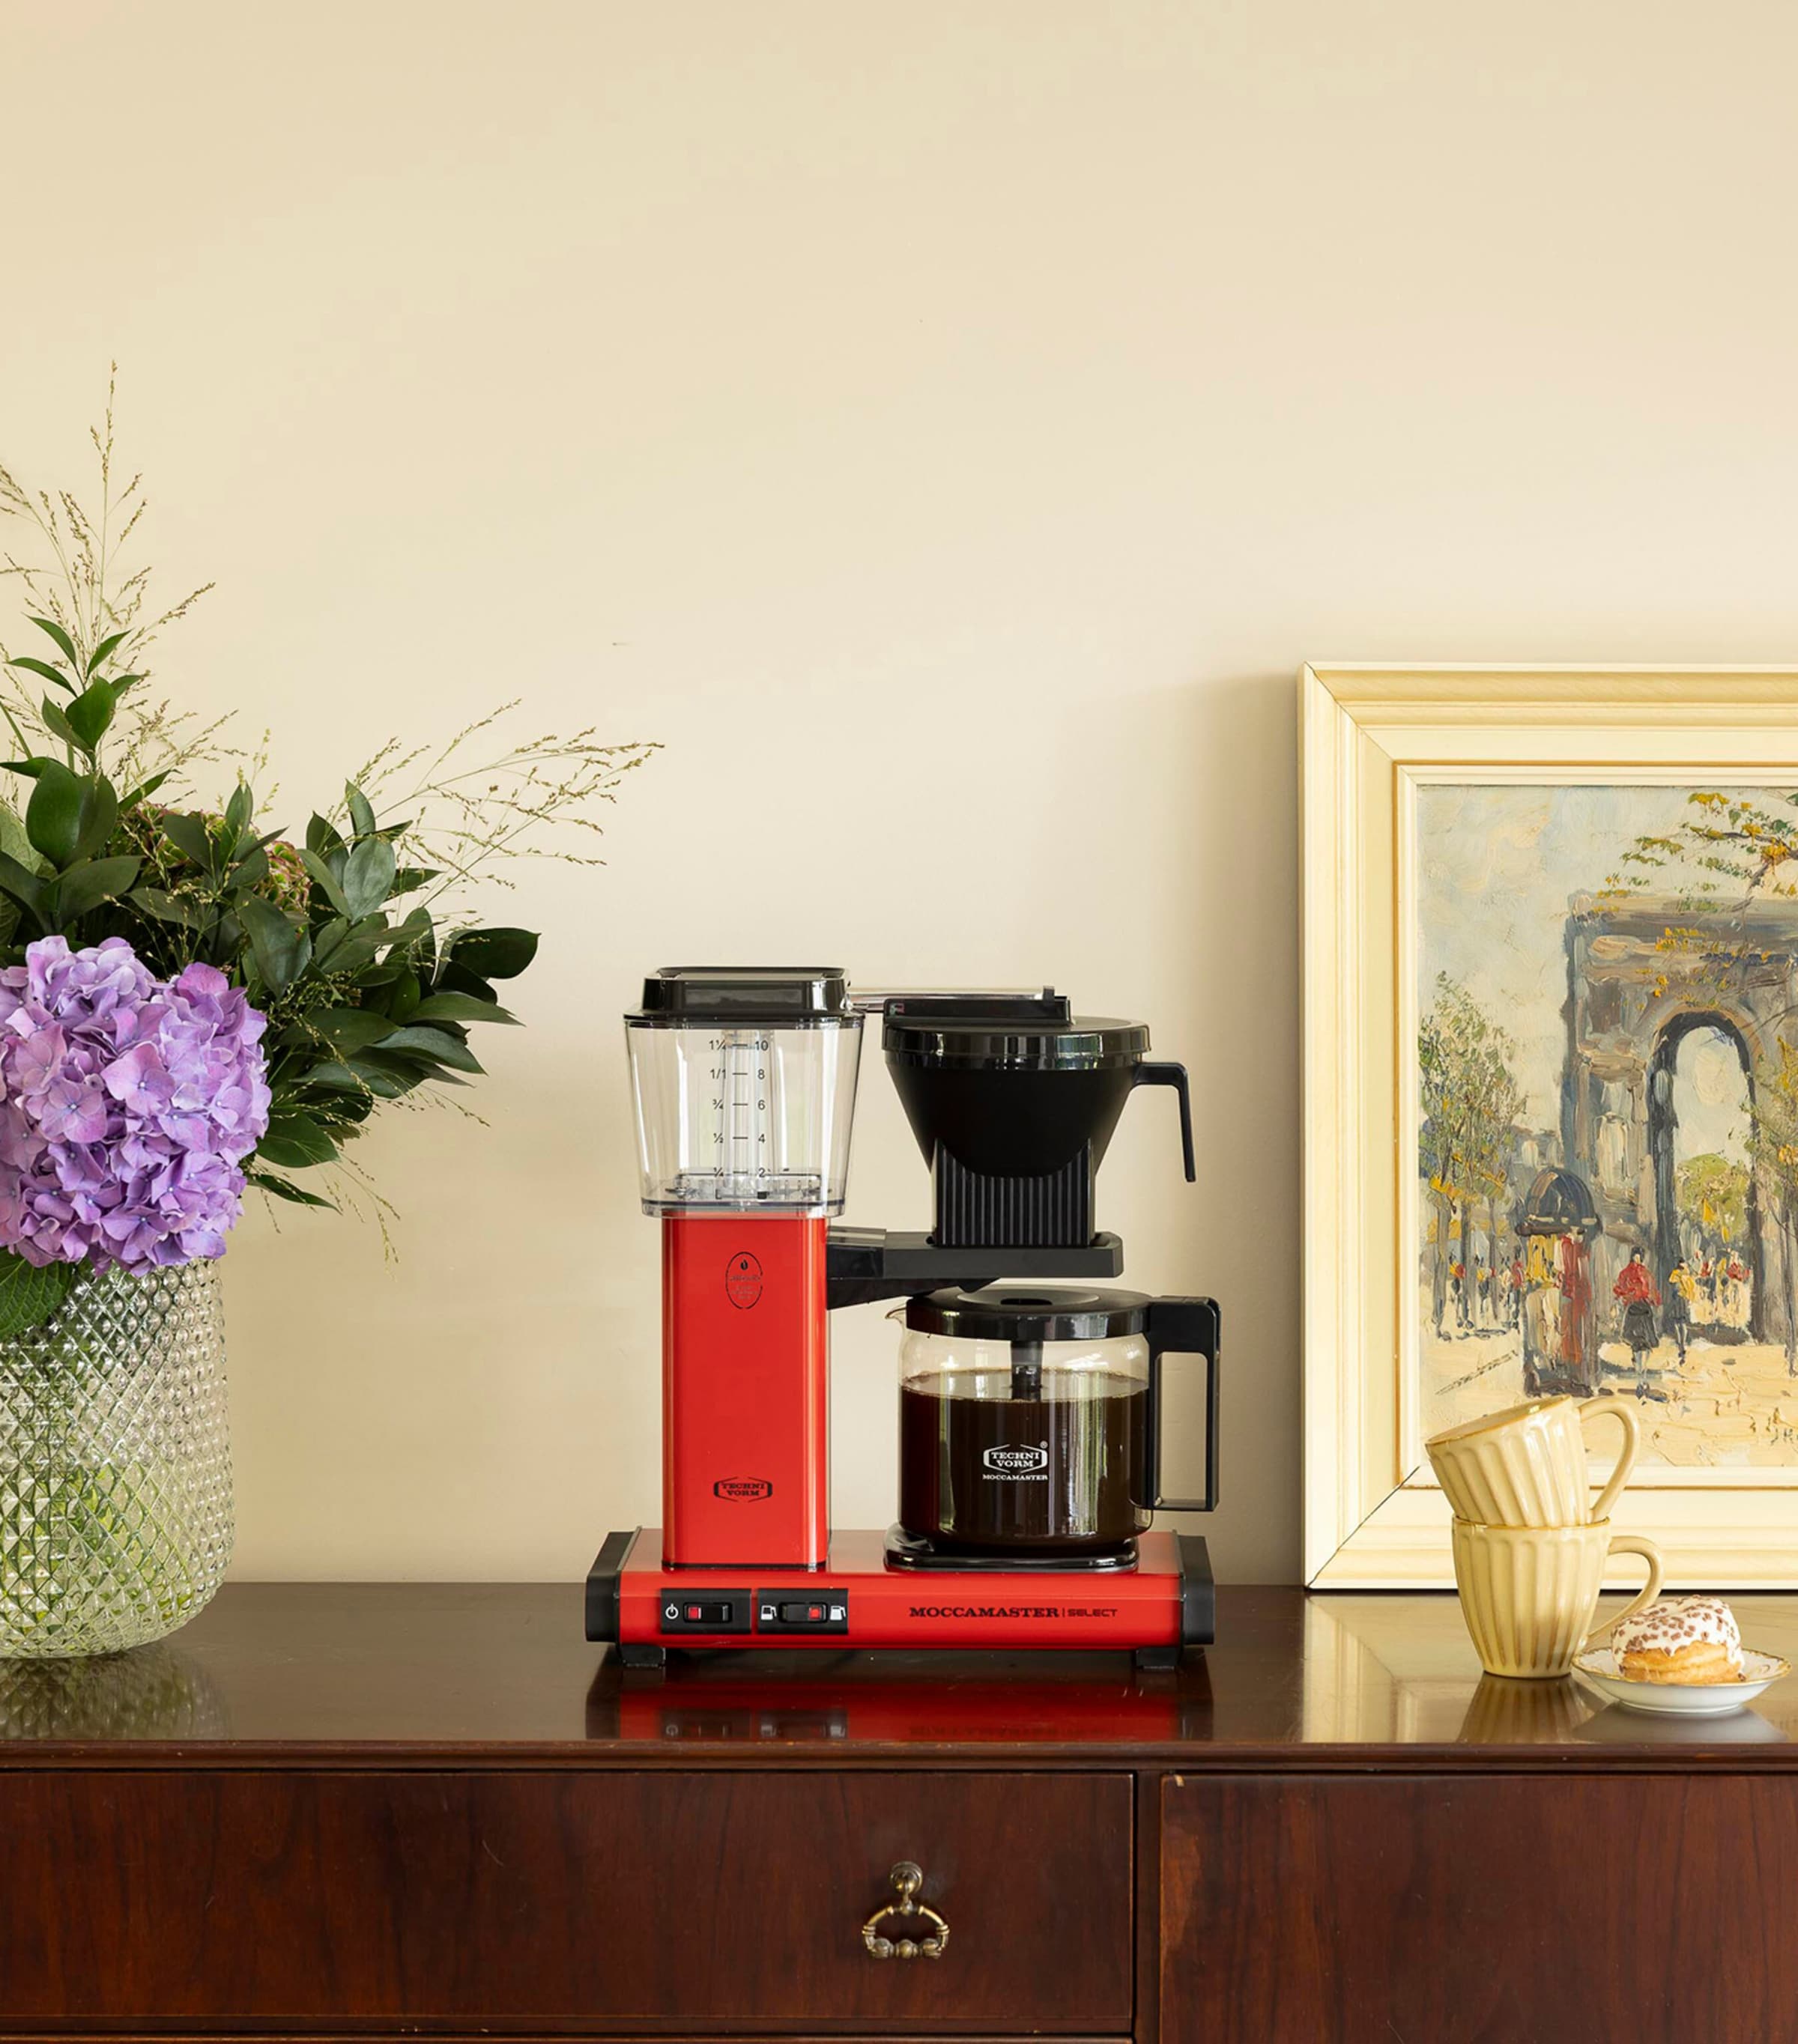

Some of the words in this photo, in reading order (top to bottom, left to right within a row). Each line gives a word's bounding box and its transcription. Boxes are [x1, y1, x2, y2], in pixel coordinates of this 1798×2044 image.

[755, 1040, 769, 1051] 10
[709, 1069, 726, 1079] 1/1
[757, 1069, 765, 1080] 8
[757, 1100, 766, 1110] 6
[758, 1133, 765, 1143] 4
[758, 1168, 765, 1177] 2
[909, 1607, 1059, 1619] MOCCAMASTER
[1068, 1609, 1117, 1617] SELECT
